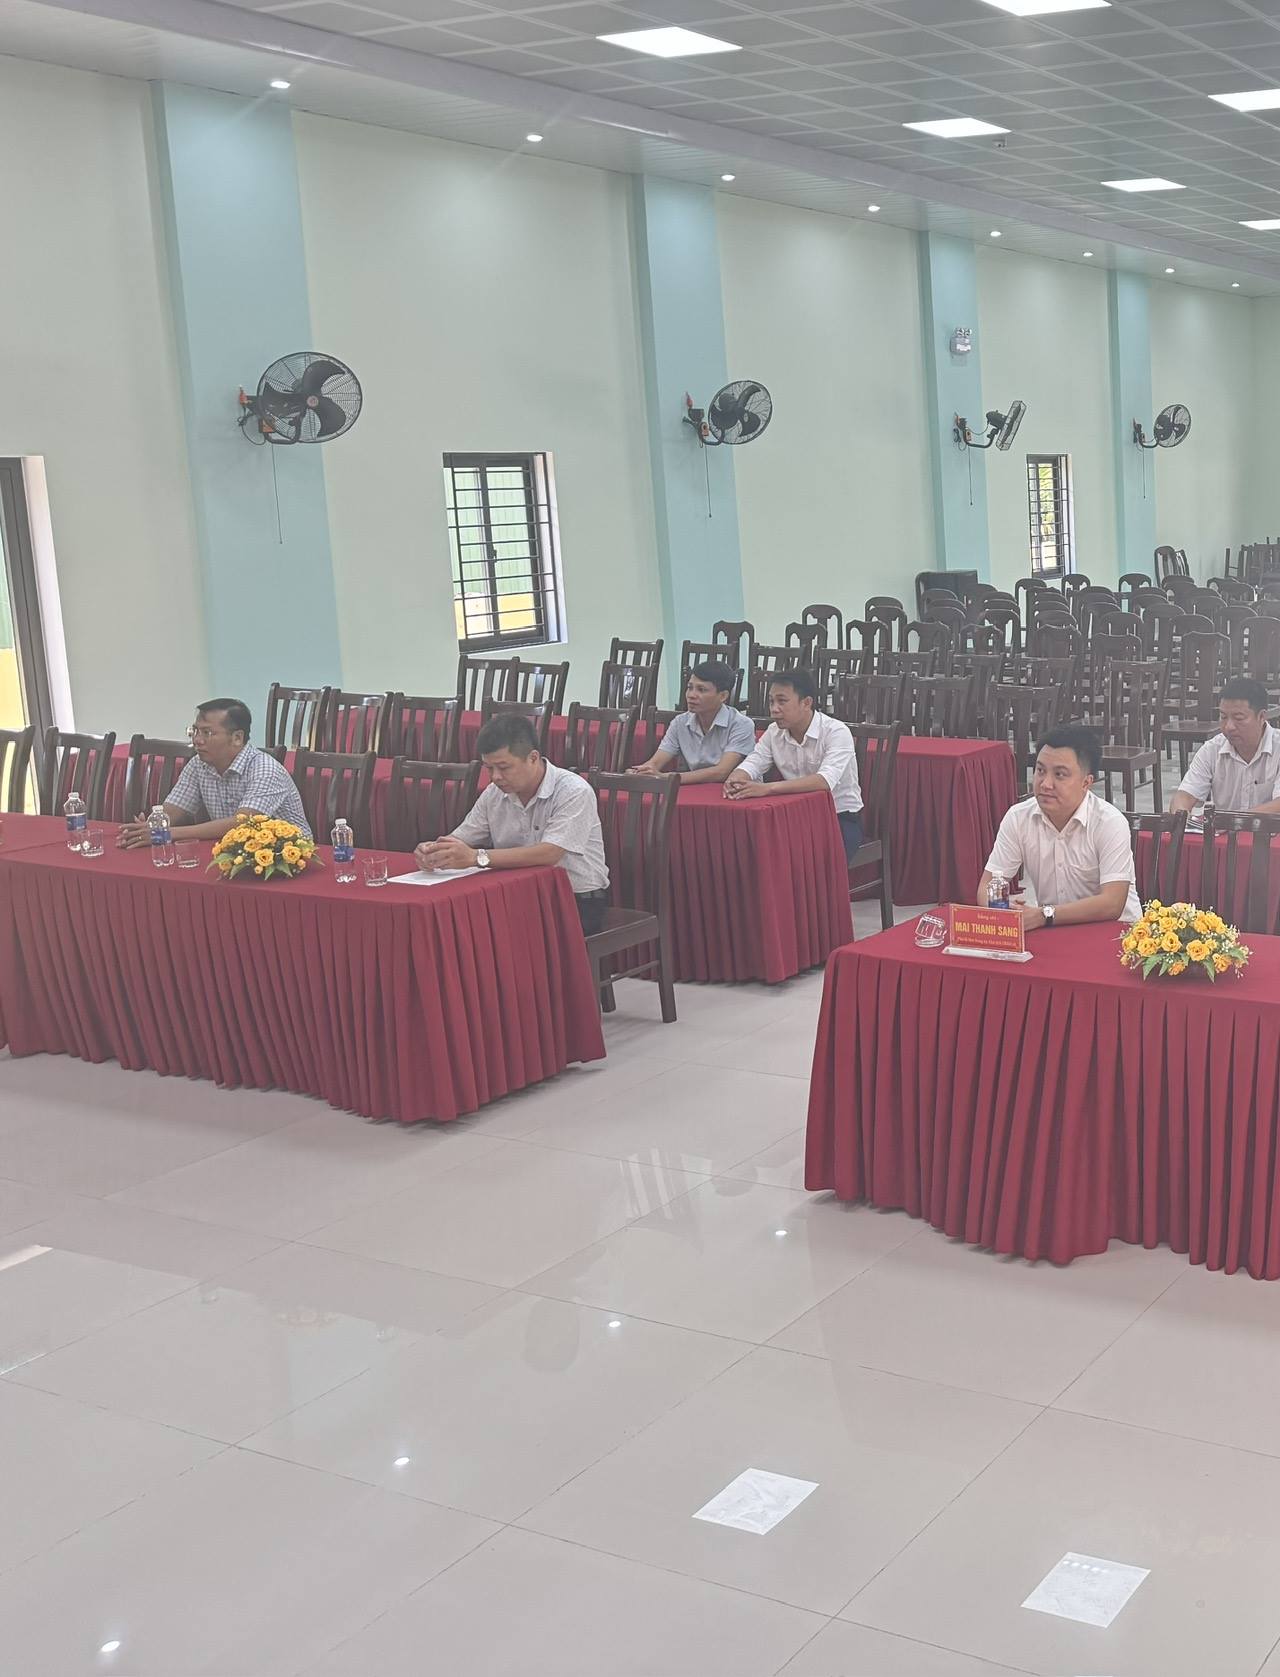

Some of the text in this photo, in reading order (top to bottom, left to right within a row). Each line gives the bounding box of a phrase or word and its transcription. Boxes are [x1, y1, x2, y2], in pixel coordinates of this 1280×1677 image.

[955, 922, 1018, 938] MAI THANH SANG
